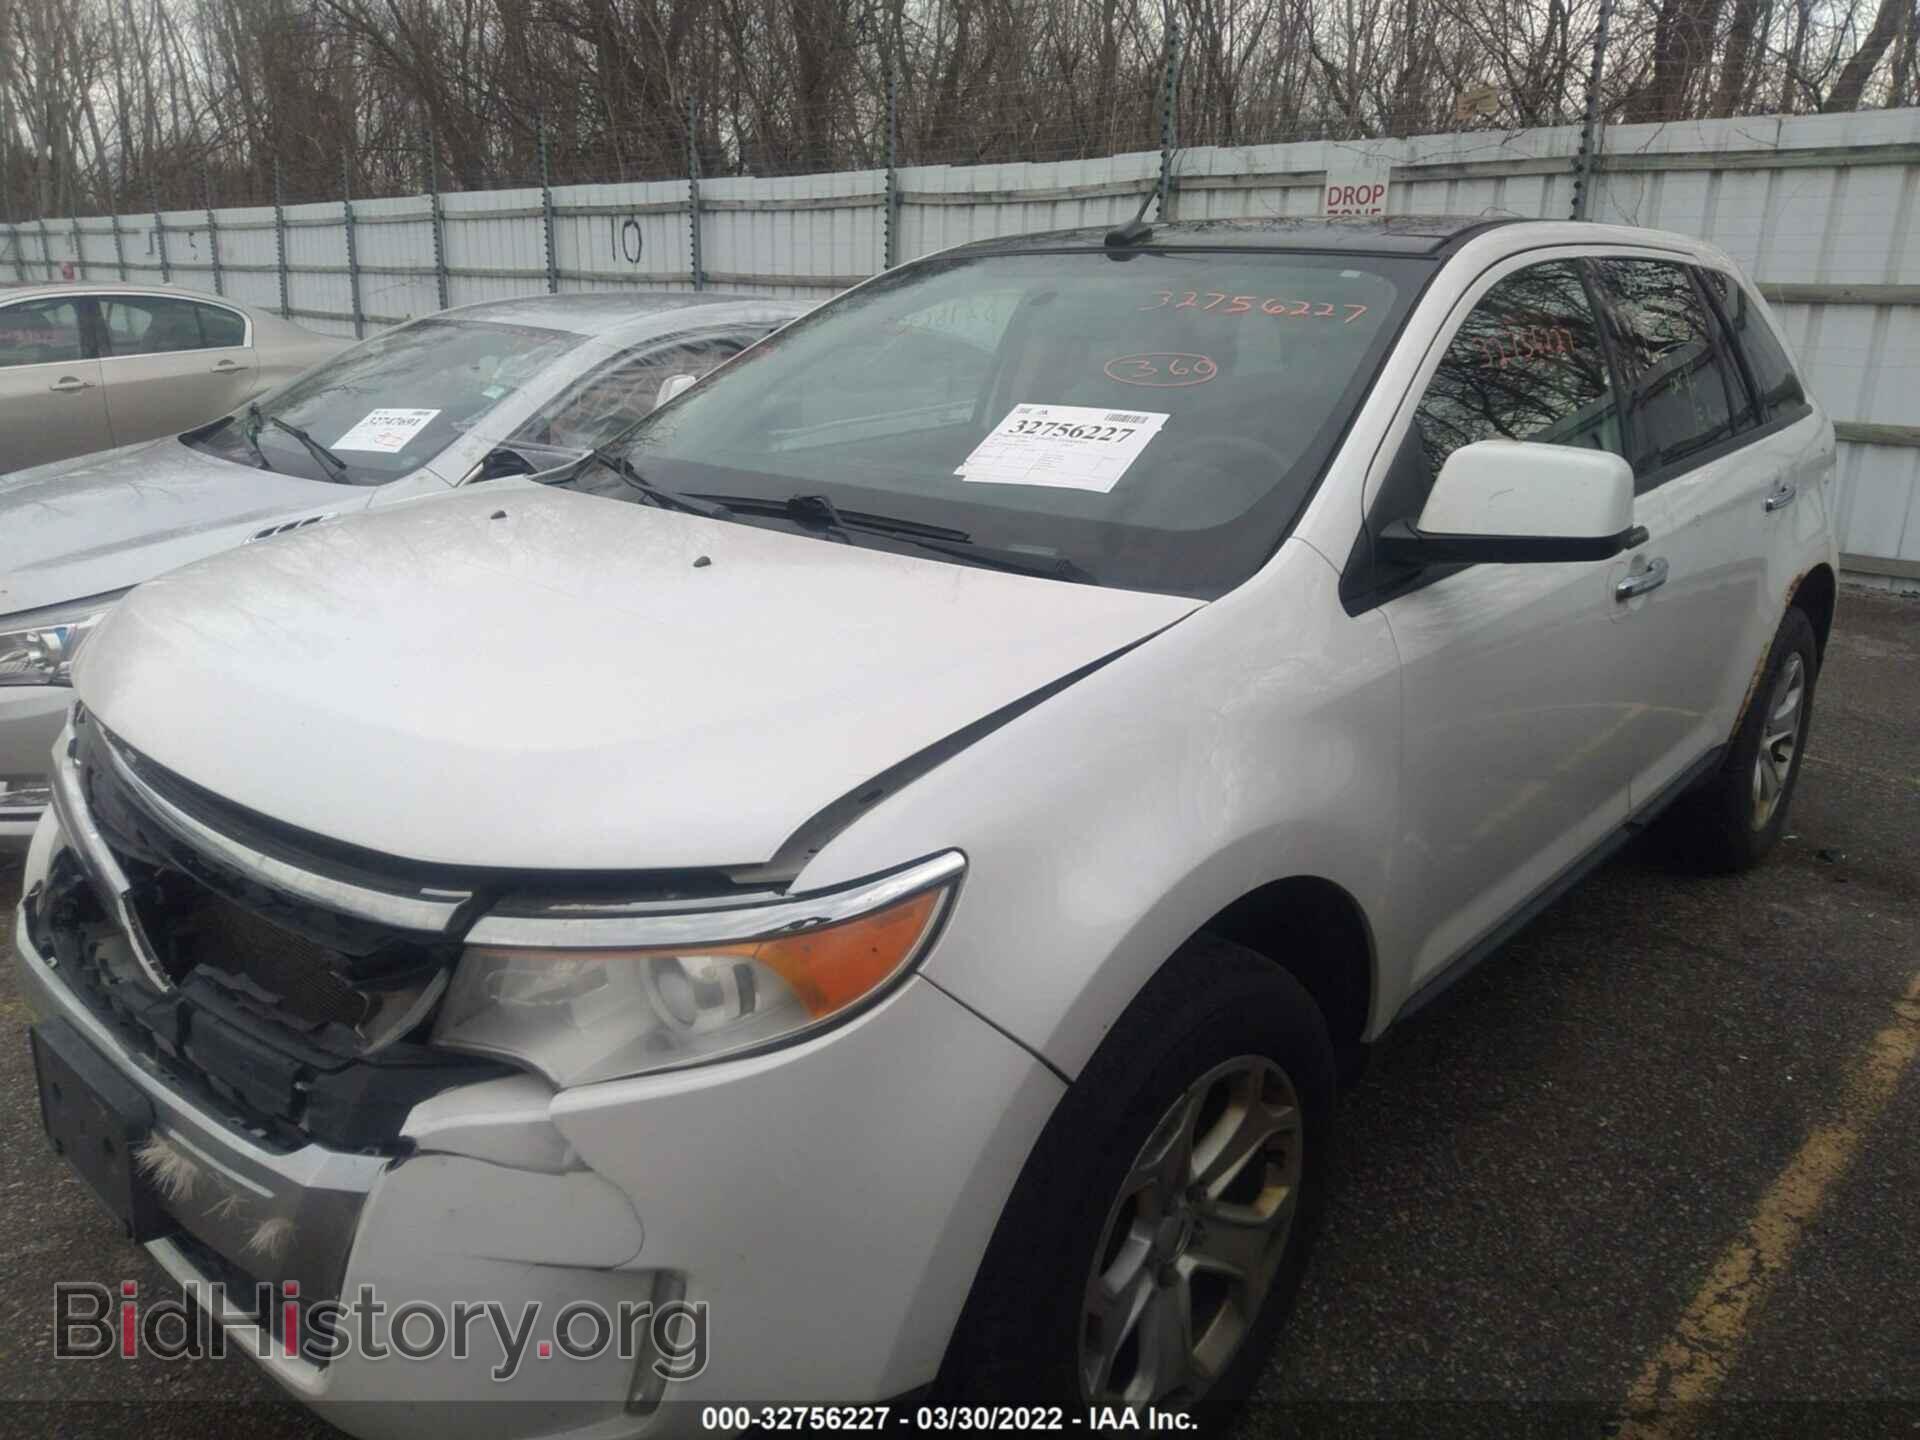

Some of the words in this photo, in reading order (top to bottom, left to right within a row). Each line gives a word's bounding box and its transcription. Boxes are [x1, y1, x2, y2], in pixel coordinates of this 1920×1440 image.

[1327, 184, 1385, 206] DROP
[1137, 290, 1368, 324] 32756227
[1115, 356, 1217, 380] 360
[1006, 419, 1137, 443] 32756227
